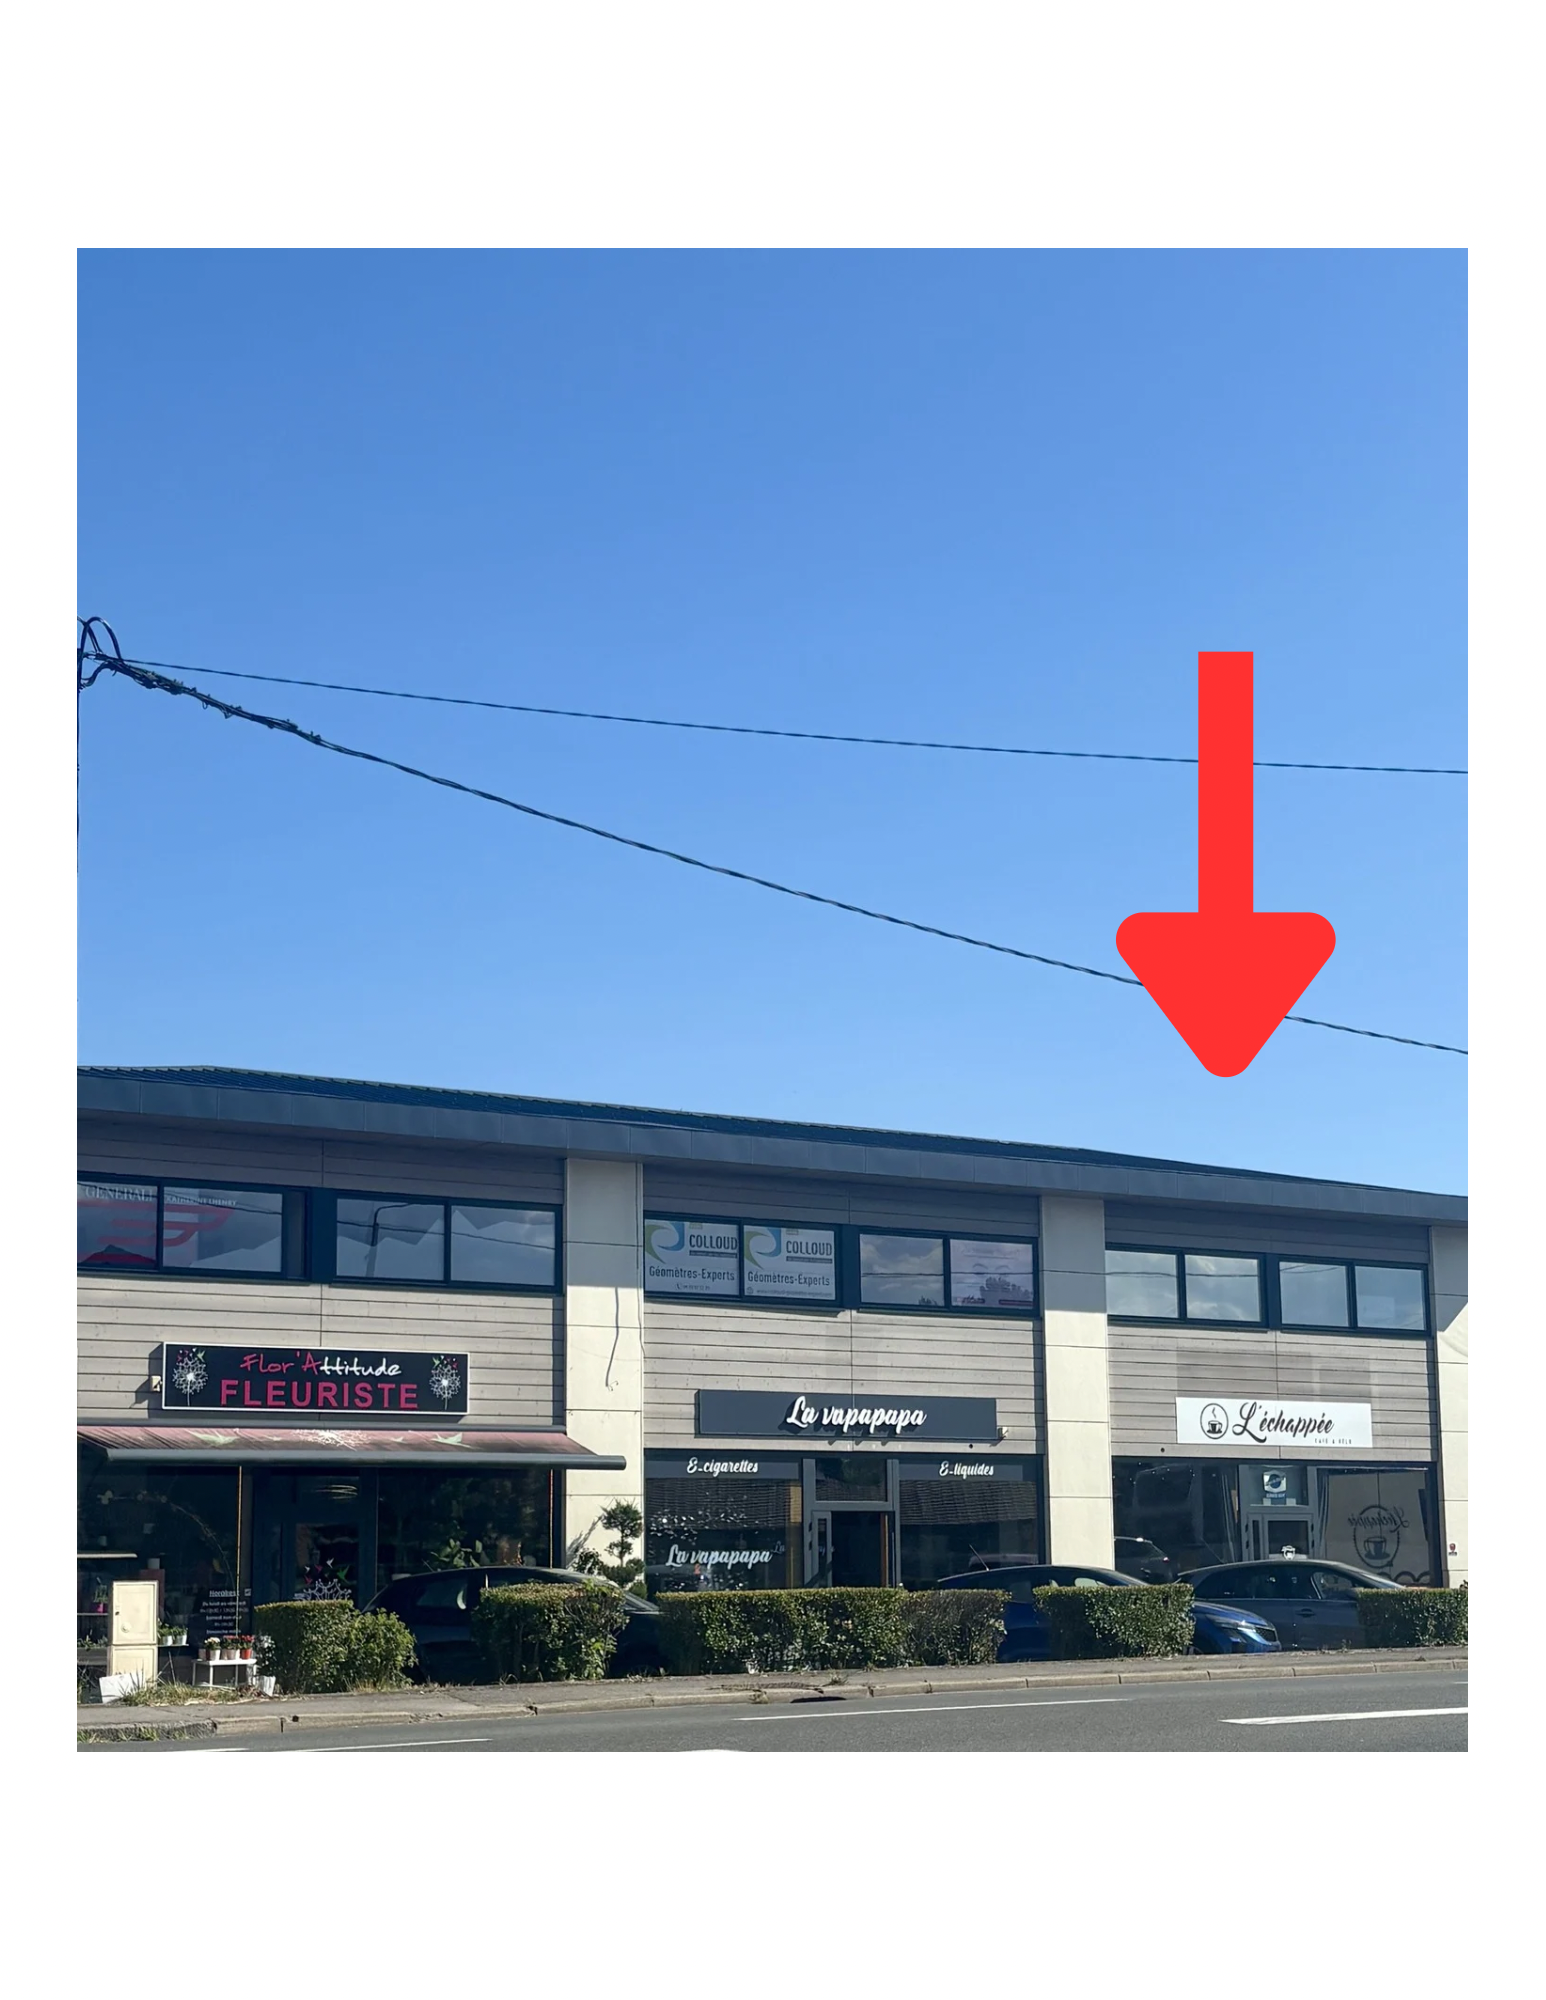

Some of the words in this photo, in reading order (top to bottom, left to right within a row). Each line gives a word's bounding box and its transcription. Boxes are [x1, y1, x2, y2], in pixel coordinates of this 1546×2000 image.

[689, 1234, 738, 1250] COLLOUD
[786, 1240, 832, 1256] COLLOUD
[649, 1265, 735, 1282] Géomètres-Experts
[747, 1271, 830, 1287] Géomètres-Experts
[220, 1379, 419, 1409] FLEURISTE
[786, 1396, 820, 1429] La
[821, 1405, 927, 1434] vapapapa
[1231, 1401, 1336, 1443] L'échappée
[665, 1544, 689, 1567] La
[689, 1550, 773, 1569] vapapapa
